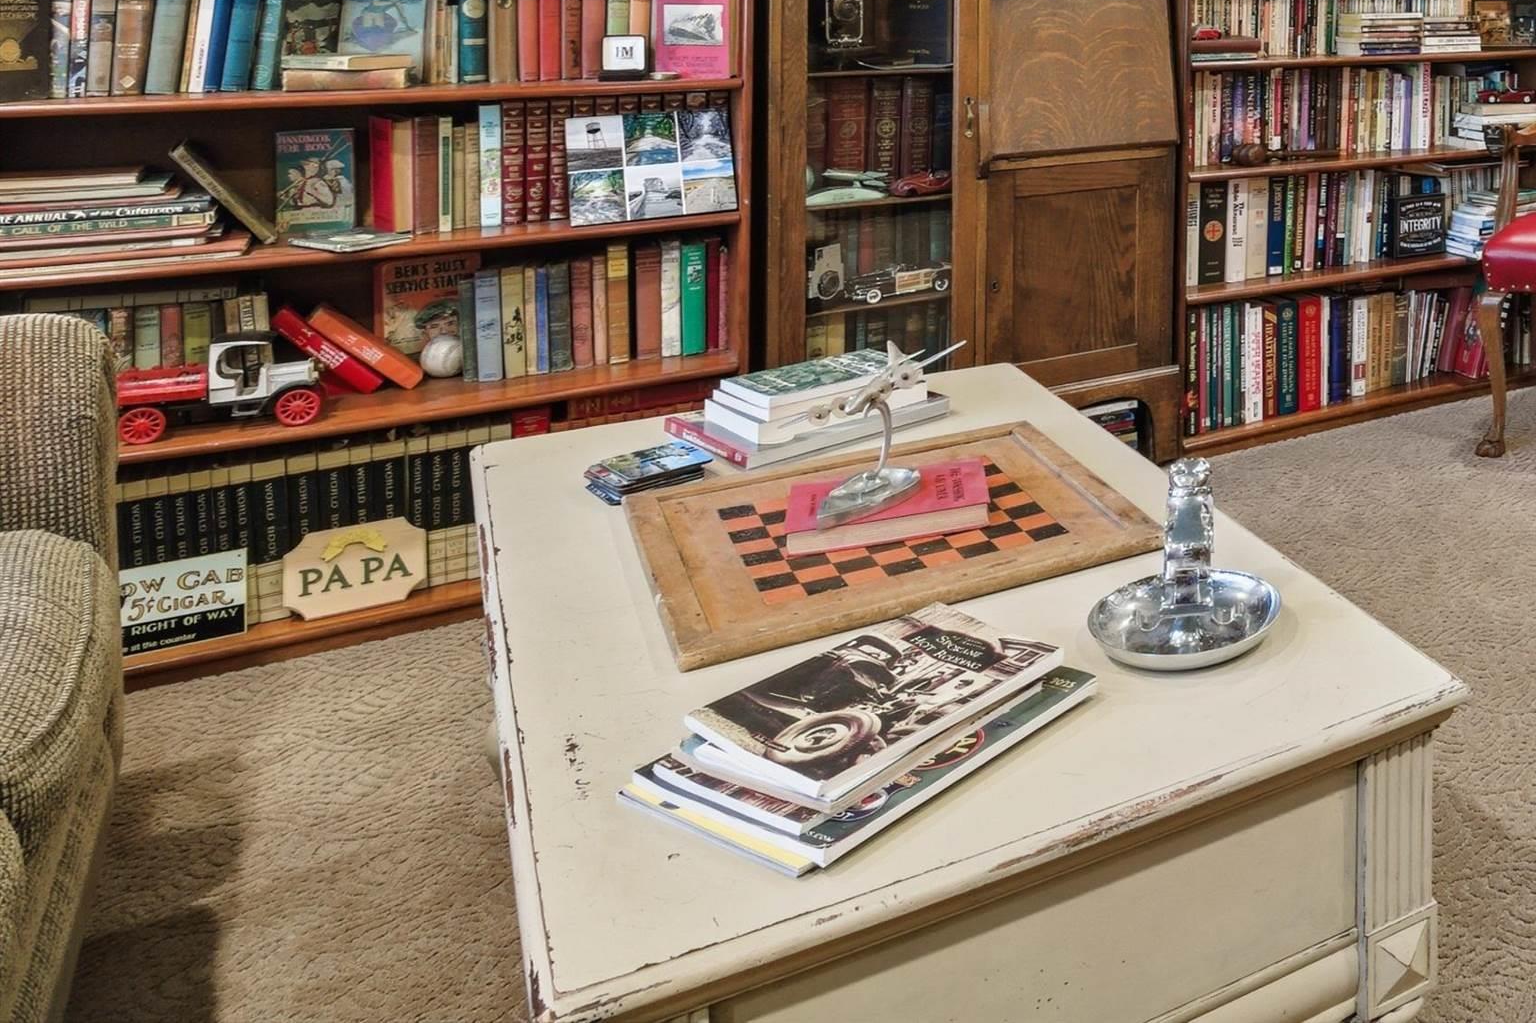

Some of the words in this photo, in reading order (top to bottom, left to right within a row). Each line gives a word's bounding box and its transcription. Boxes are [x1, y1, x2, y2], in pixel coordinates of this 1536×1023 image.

[12, 224, 43, 236] CALL
[47, 223, 65, 234] OF
[71, 220, 97, 232] THE
[99, 219, 129, 230] WILD
[1399, 216, 1442, 234] INTEGRITY
[356, 467, 367, 504] WORLD
[385, 462, 394, 499] WORLD
[414, 458, 423, 494] WORLD
[432, 455, 441, 491] WORLD
[452, 451, 462, 488] WORLD
[236, 487, 247, 525] WORLD
[264, 482, 275, 521] WORLD
[299, 476, 308, 514] WORLD
[329, 471, 339, 509] WORLD
[131, 504, 142, 543] WORLD
[154, 501, 164, 539] WORLD
[175, 497, 185, 536] WORLD
[197, 494, 207, 532] WORLD
[217, 490, 227, 529] WORLD
[176, 567, 245, 591] CAB
[131, 617, 179, 637] RIGHT
[183, 614, 202, 627] OF
[206, 606, 240, 621] WAY
[159, 632, 198, 647] counter
[910, 634, 937, 652] HOT
